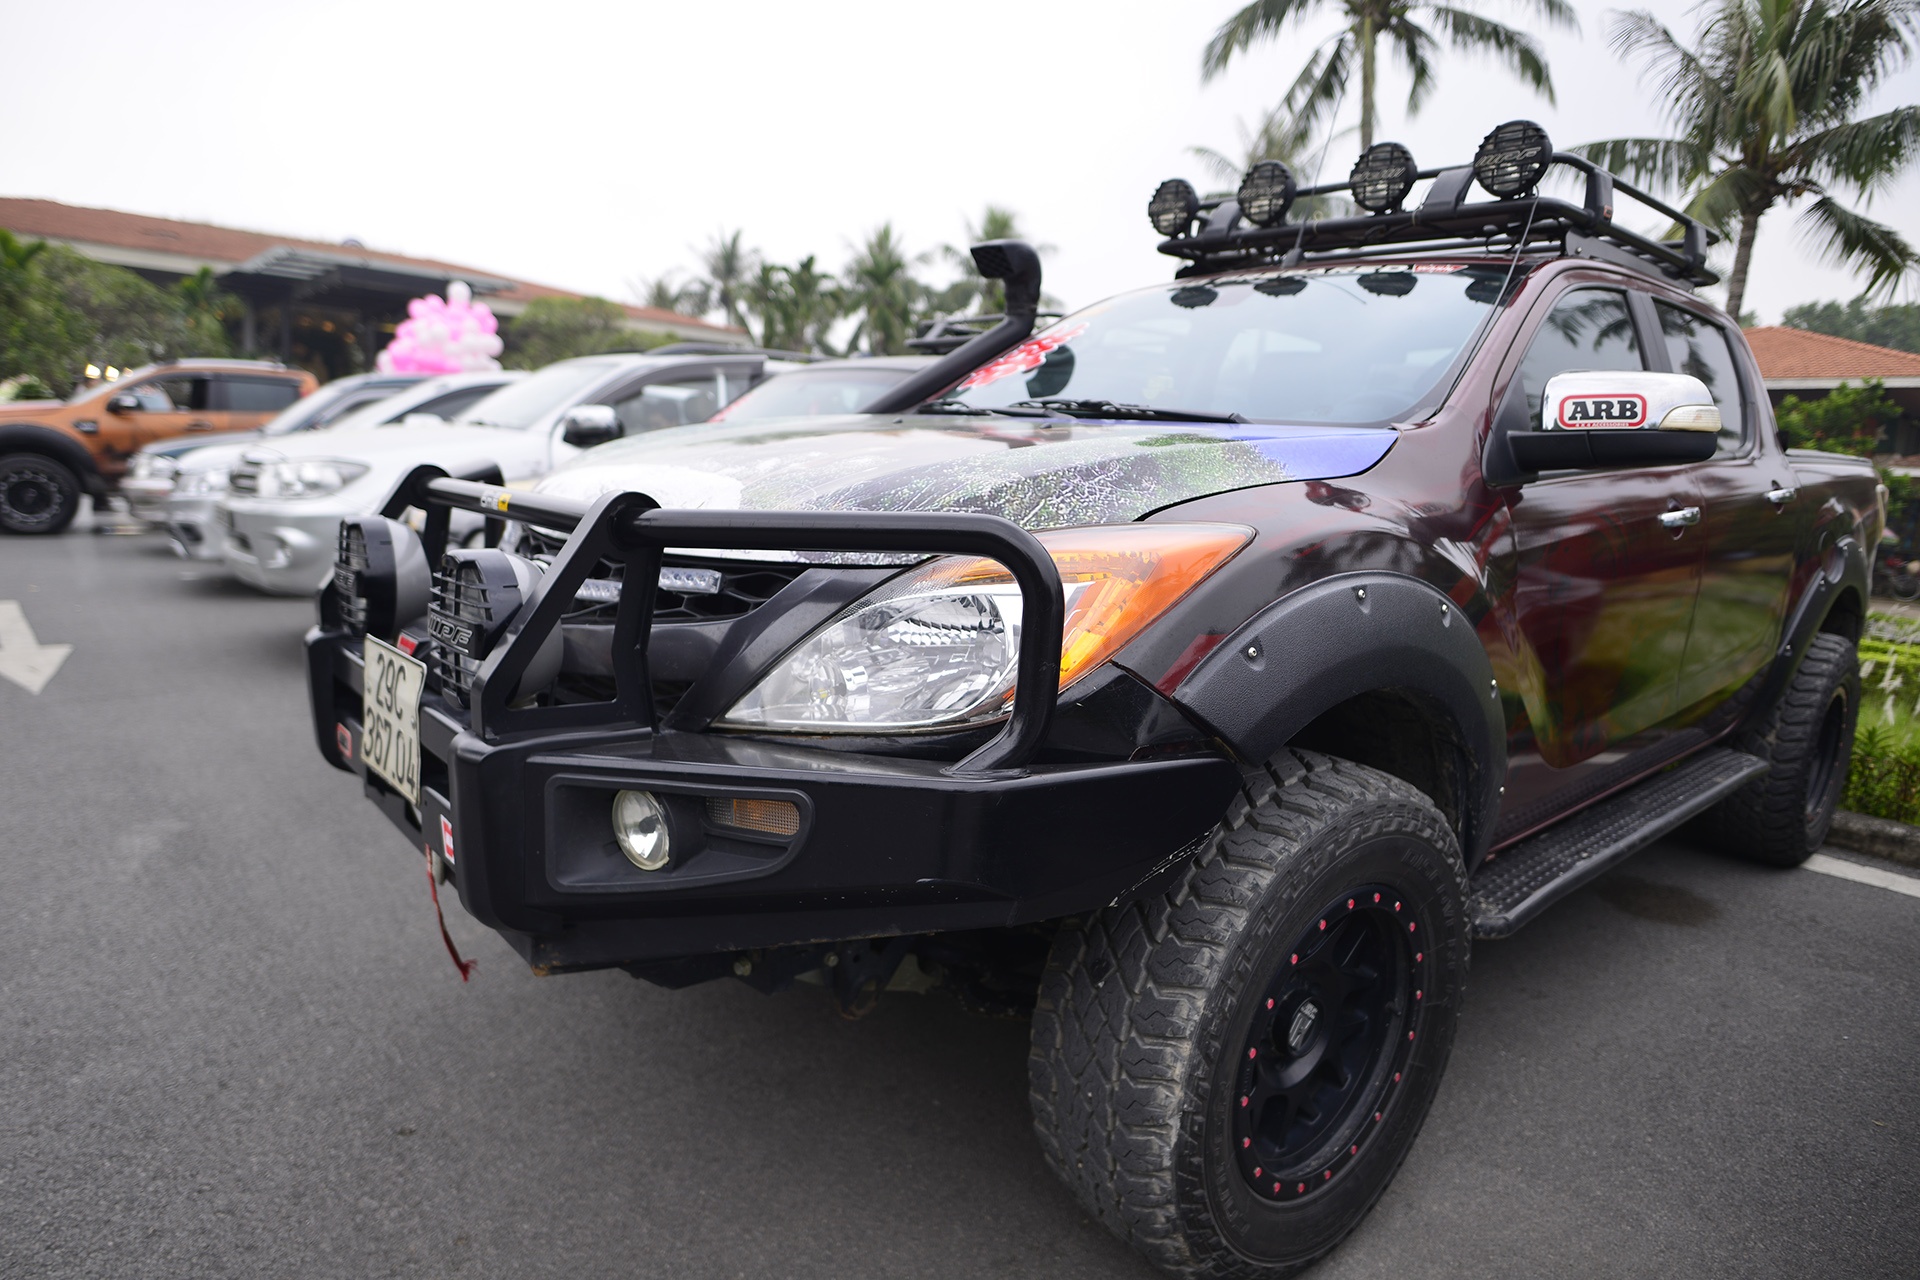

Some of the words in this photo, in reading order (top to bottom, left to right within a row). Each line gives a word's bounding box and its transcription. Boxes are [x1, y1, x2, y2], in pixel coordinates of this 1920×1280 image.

[1568, 400, 1638, 421] ARB
[376, 650, 407, 720] 29C
[364, 704, 416, 796] 367.04
